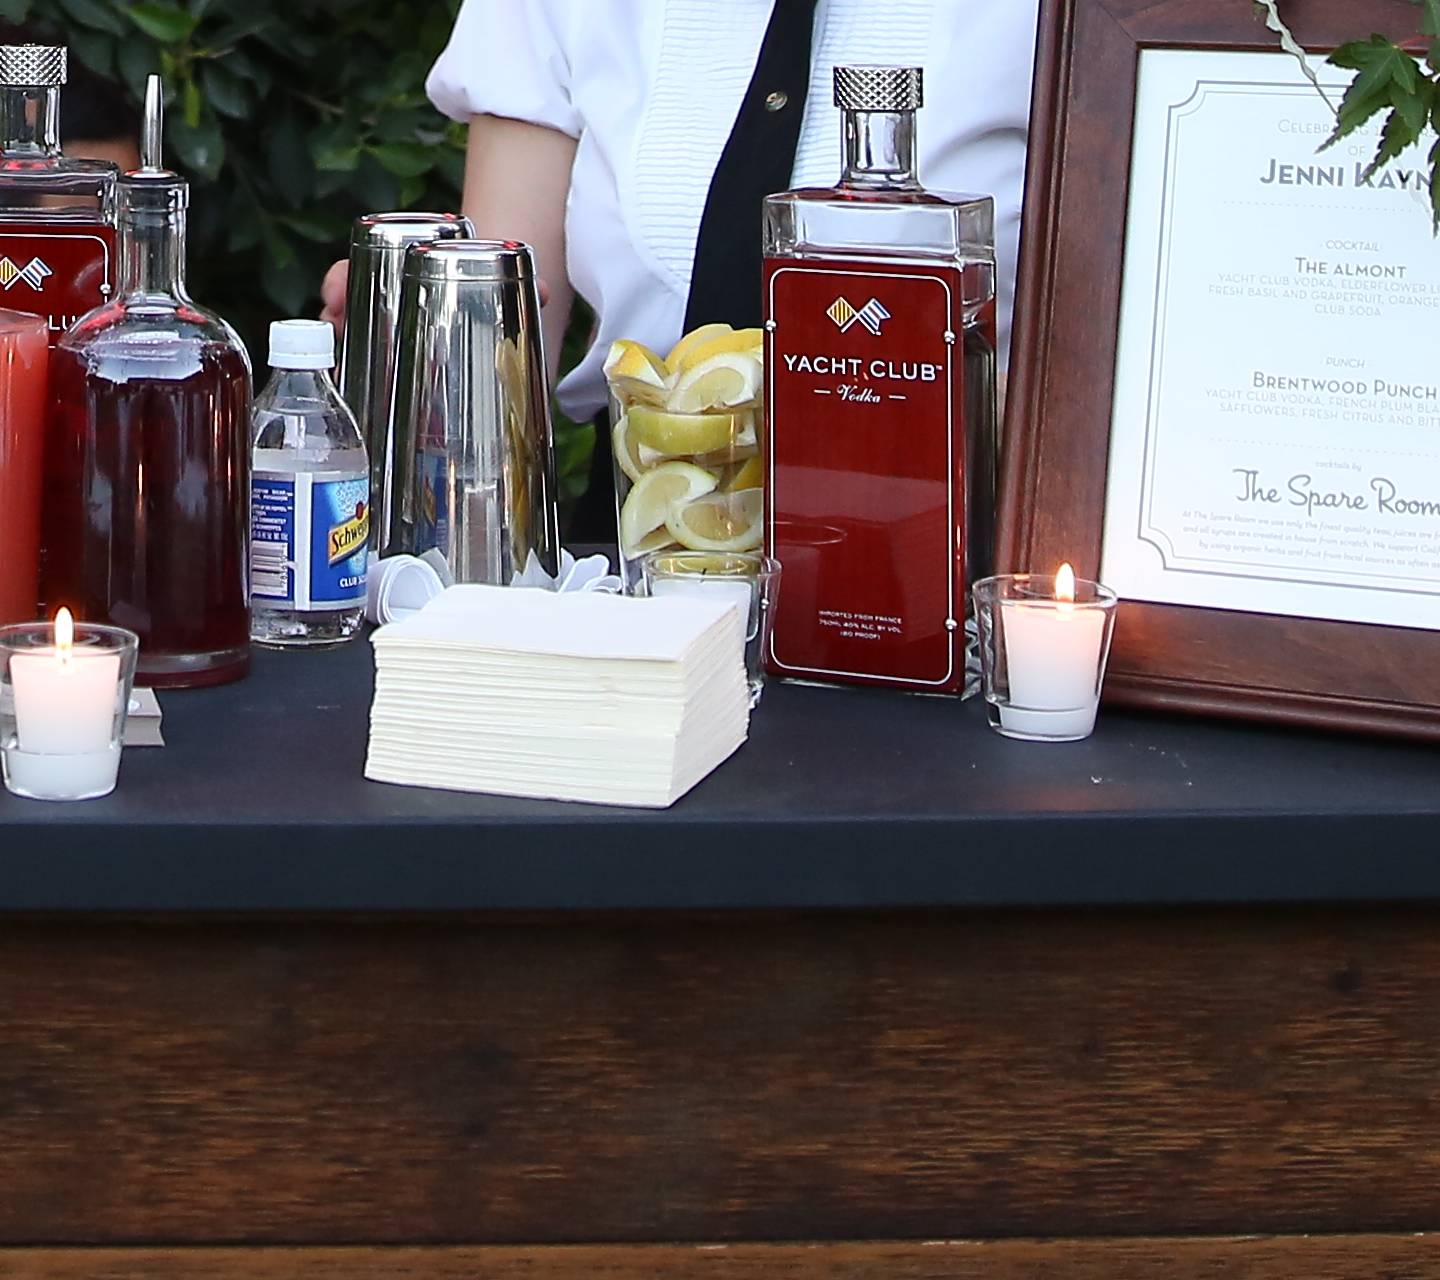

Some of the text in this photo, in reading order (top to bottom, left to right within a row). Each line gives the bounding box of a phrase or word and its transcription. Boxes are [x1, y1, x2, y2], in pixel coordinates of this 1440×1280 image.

[1259, 158, 1431, 191] JENNI KAYN
[783, 354, 862, 376] YACHT
[836, 383, 882, 404] Vodka
[1252, 370, 1438, 401] BRENTWOOD PUNCH
[1232, 468, 1282, 503] The
[1287, 473, 1369, 517] Spare
